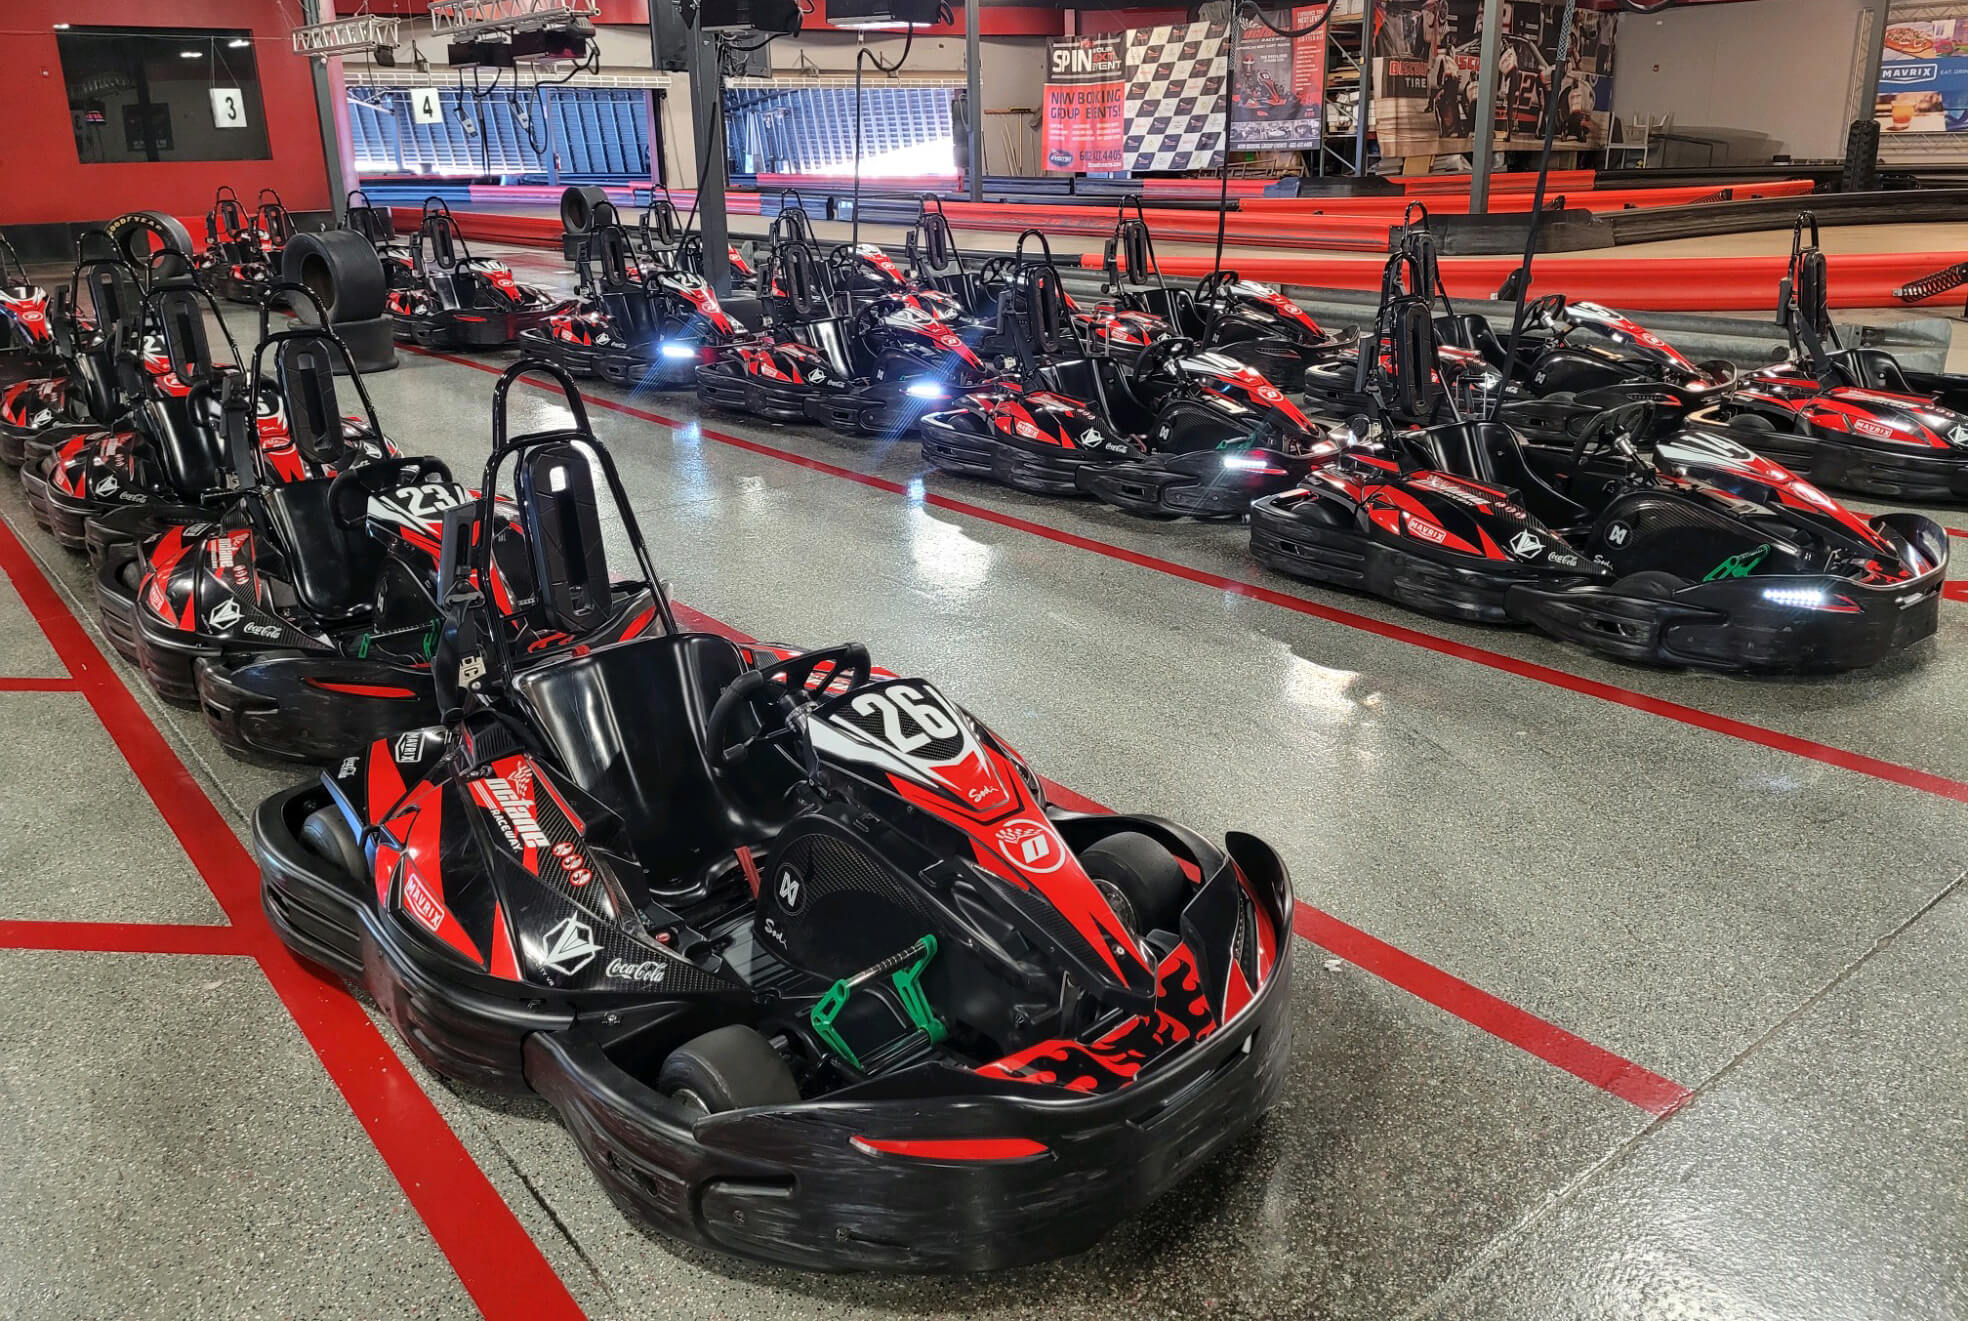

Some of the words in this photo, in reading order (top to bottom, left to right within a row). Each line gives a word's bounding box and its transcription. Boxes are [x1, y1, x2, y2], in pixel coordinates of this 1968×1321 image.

[1052, 49, 1092, 72] SPIN
[1405, 77, 1427, 88] TIRE
[1882, 67, 1932, 79] MAVRIX
[225, 96, 237, 121] 3
[422, 95, 434, 118] 4
[1856, 420, 1891, 437] MAVRIX
[395, 483, 459, 517] 23
[1401, 521, 1445, 541] MAVRIX
[851, 685, 959, 754] 26
[400, 732, 420, 762] MAVRIX
[490, 808, 524, 853] RACEWAY
[405, 878, 442, 926] MAVRIX
